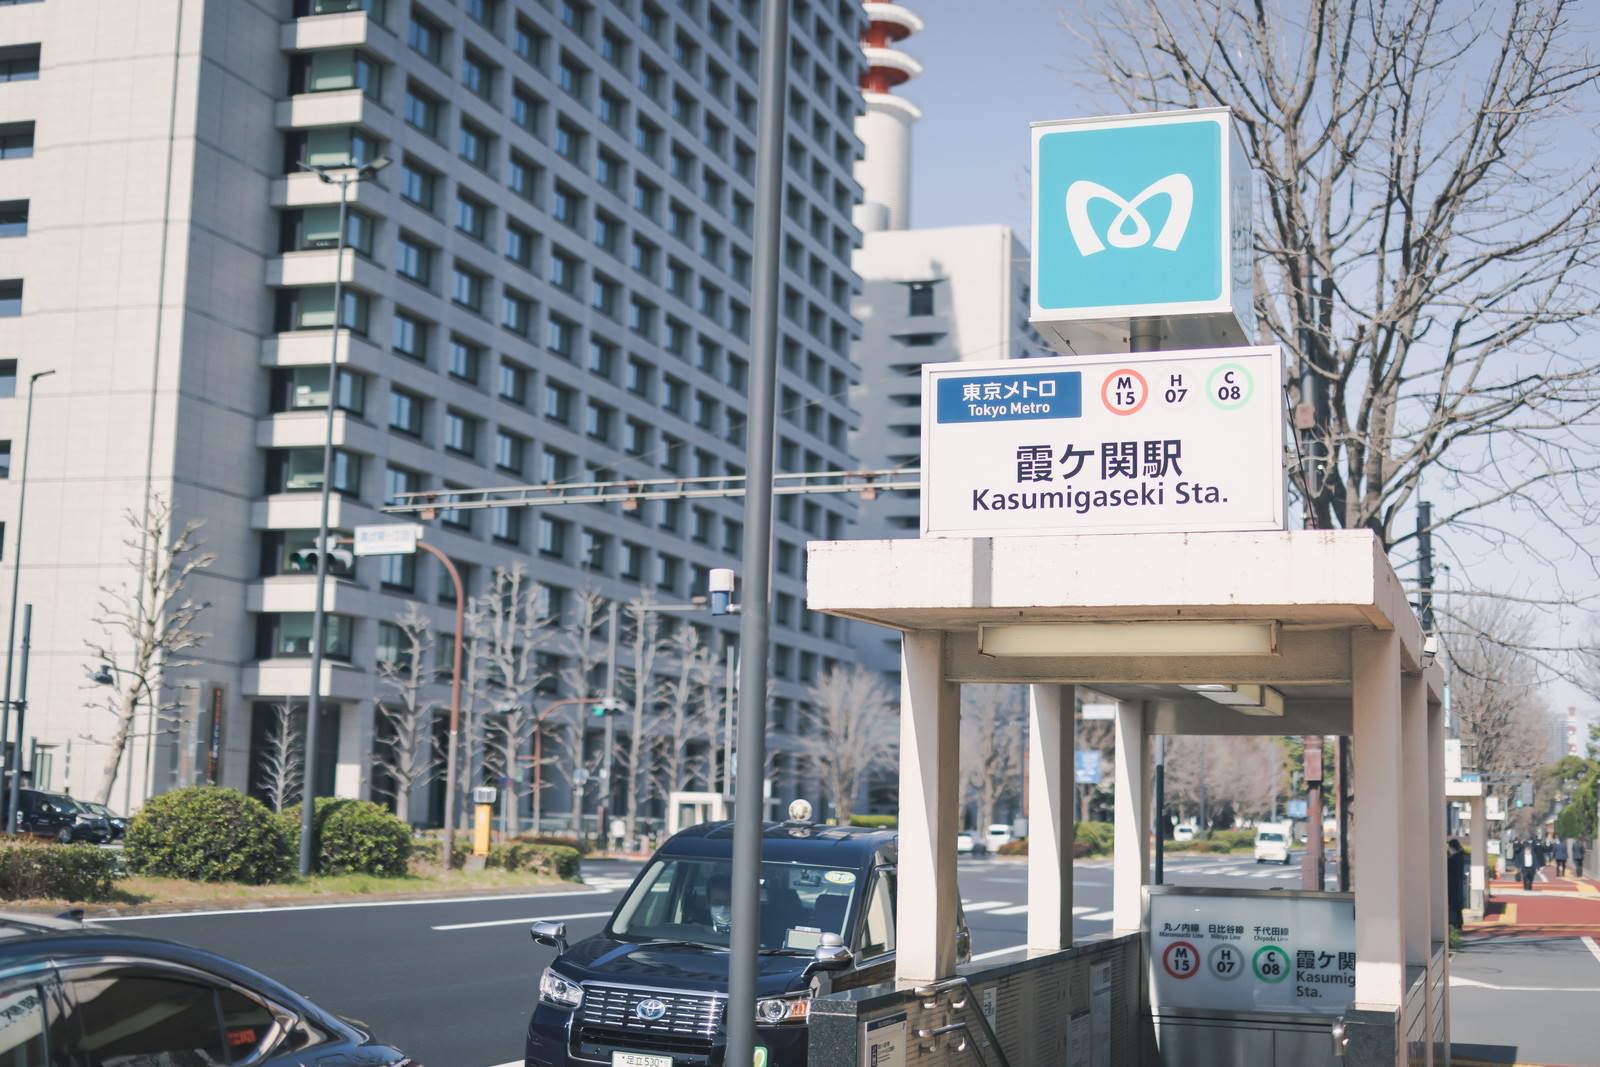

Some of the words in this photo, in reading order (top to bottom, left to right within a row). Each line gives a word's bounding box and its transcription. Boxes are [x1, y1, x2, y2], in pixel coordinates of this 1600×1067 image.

[1116, 376, 1132, 390] M
[1170, 374, 1182, 387] H
[1223, 371, 1235, 385] C
[962, 380, 1056, 401] 東京メトロ
[1164, 388, 1188, 403] 07
[1217, 386, 1241, 401] 08
[1115, 391, 1136, 406] 15
[968, 403, 1007, 418] Tokyo
[1010, 401, 1051, 415] Metro
[1016, 439, 1183, 483] 霞ケ関駅
[972, 482, 1164, 514] Kasumigaseki
[1175, 481, 1228, 505] Sta.
[1163, 922, 1199, 933] 丸ノ内線
[1208, 924, 1244, 935] 日比谷線
[1253, 926, 1289, 937] 千代田線
[1175, 948, 1188, 959] M
[1221, 950, 1231, 961] H
[1267, 952, 1276, 963] C
[1173, 960, 1191, 972] 15
[1216, 961, 1235, 973] 07
[1296, 950, 1356, 971] 霞ケ関
[1262, 963, 1281, 976] 08
[1296, 985, 1323, 998] Sta.
